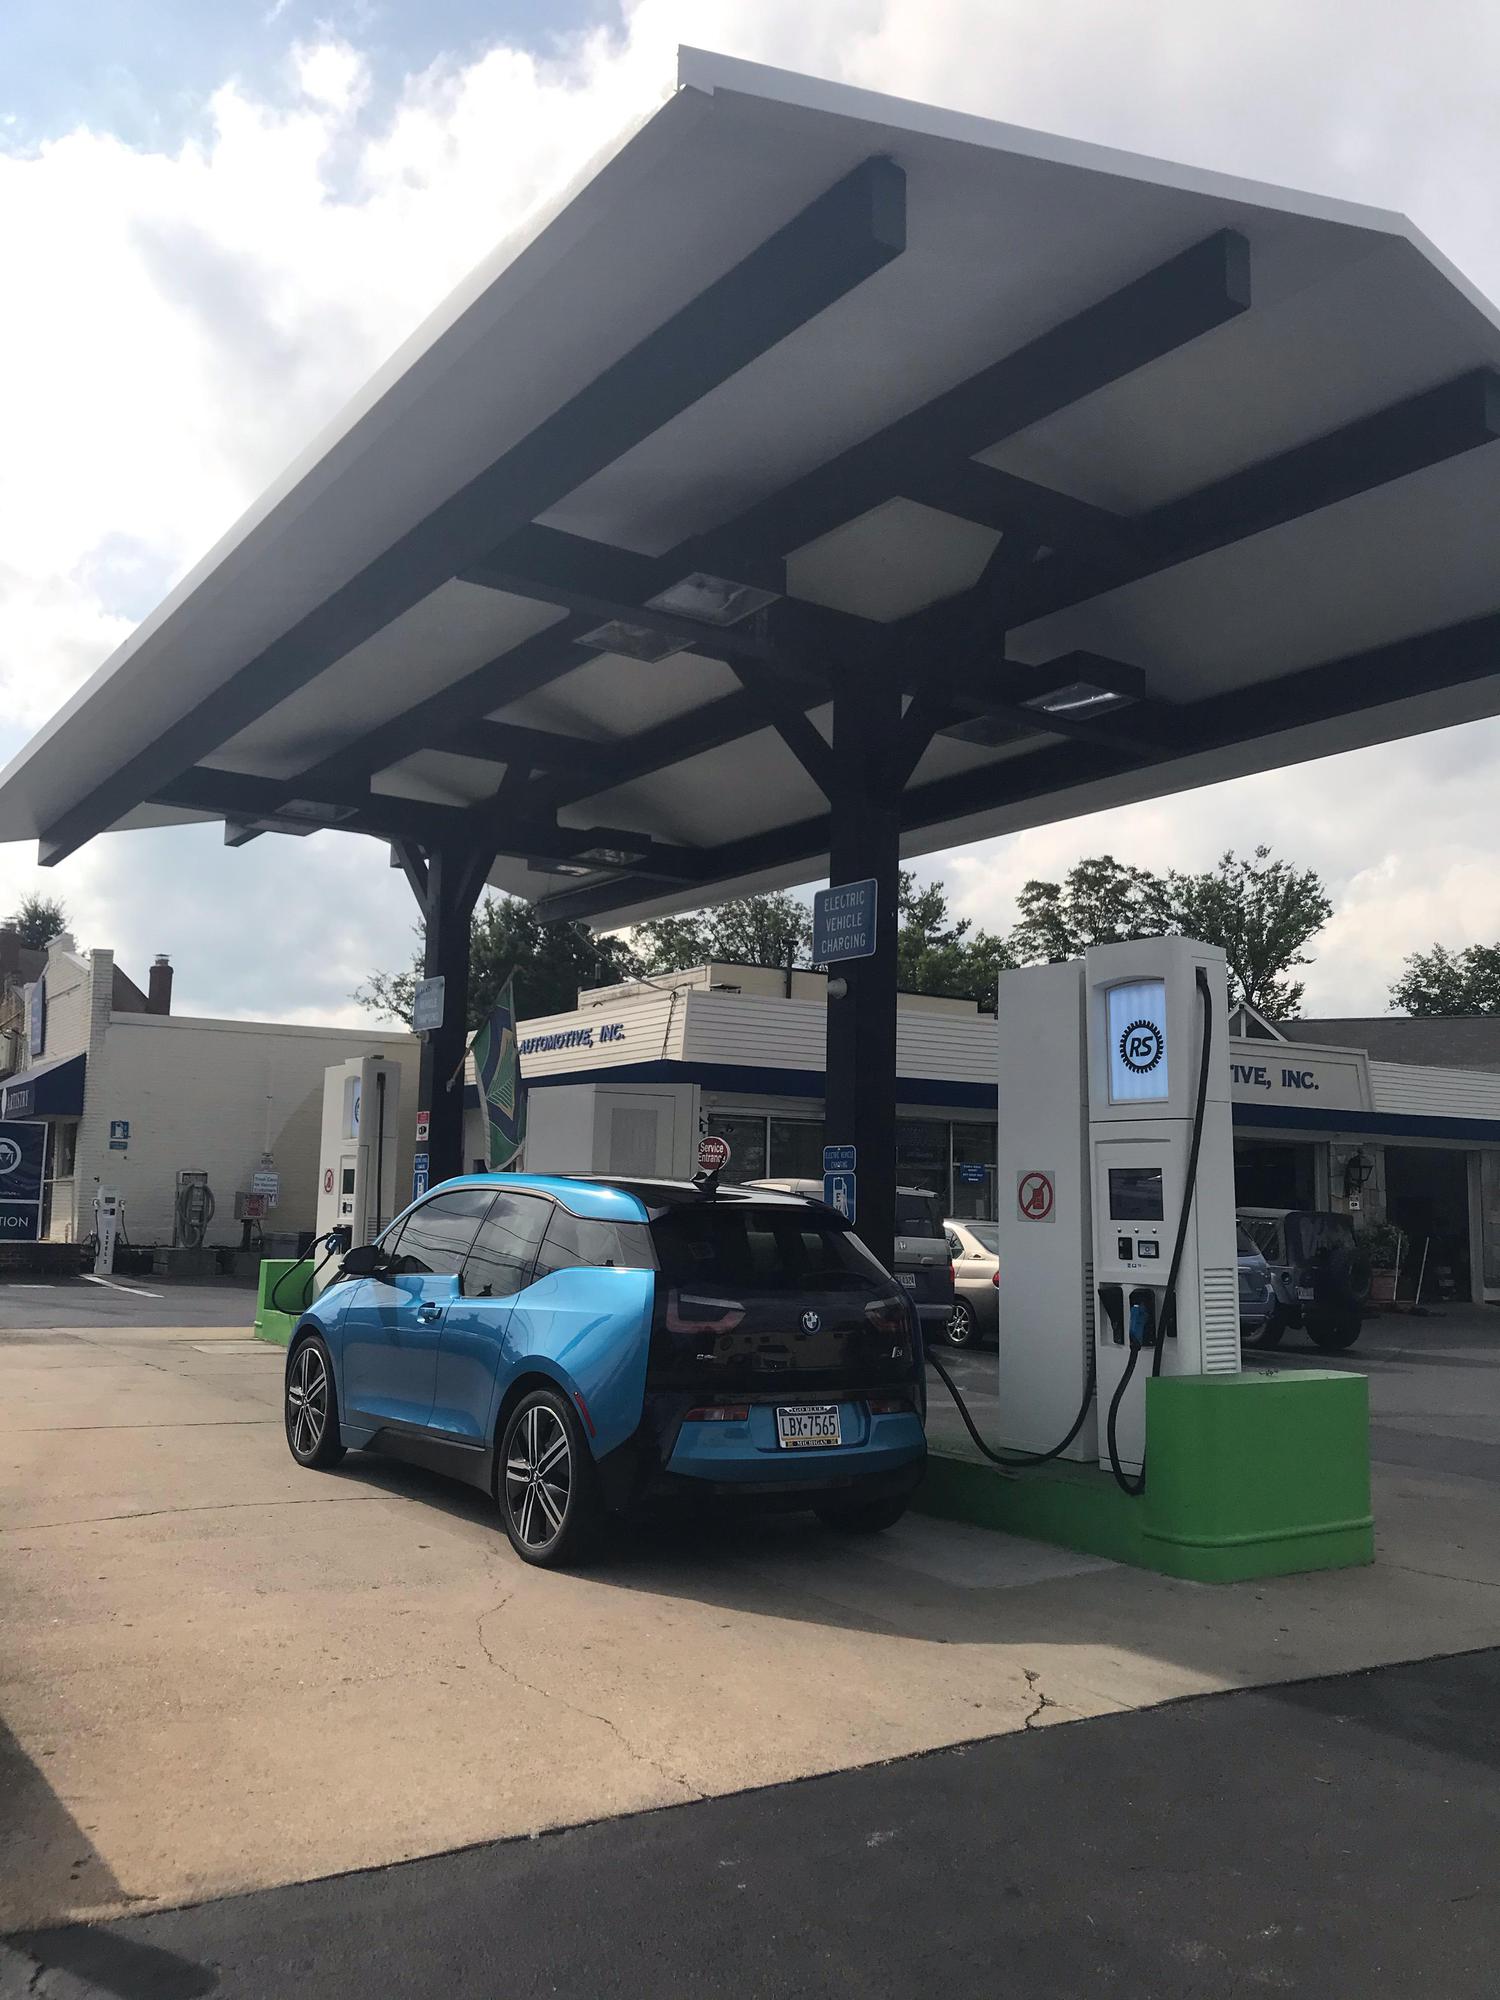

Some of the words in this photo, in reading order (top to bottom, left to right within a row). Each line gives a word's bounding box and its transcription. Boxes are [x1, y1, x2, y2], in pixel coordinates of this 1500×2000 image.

[824, 890, 865, 912] ELECTRIC
[826, 912, 863, 932] VEHICLE
[821, 932, 866, 954] CHARGING
[519, 1028, 594, 1055] AUTOMOTIVE,
[599, 1023, 626, 1043] INC.
[1129, 1035, 1154, 1058] RS
[1281, 1069, 1320, 1090] INC.
[700, 1142, 724, 1153] Service
